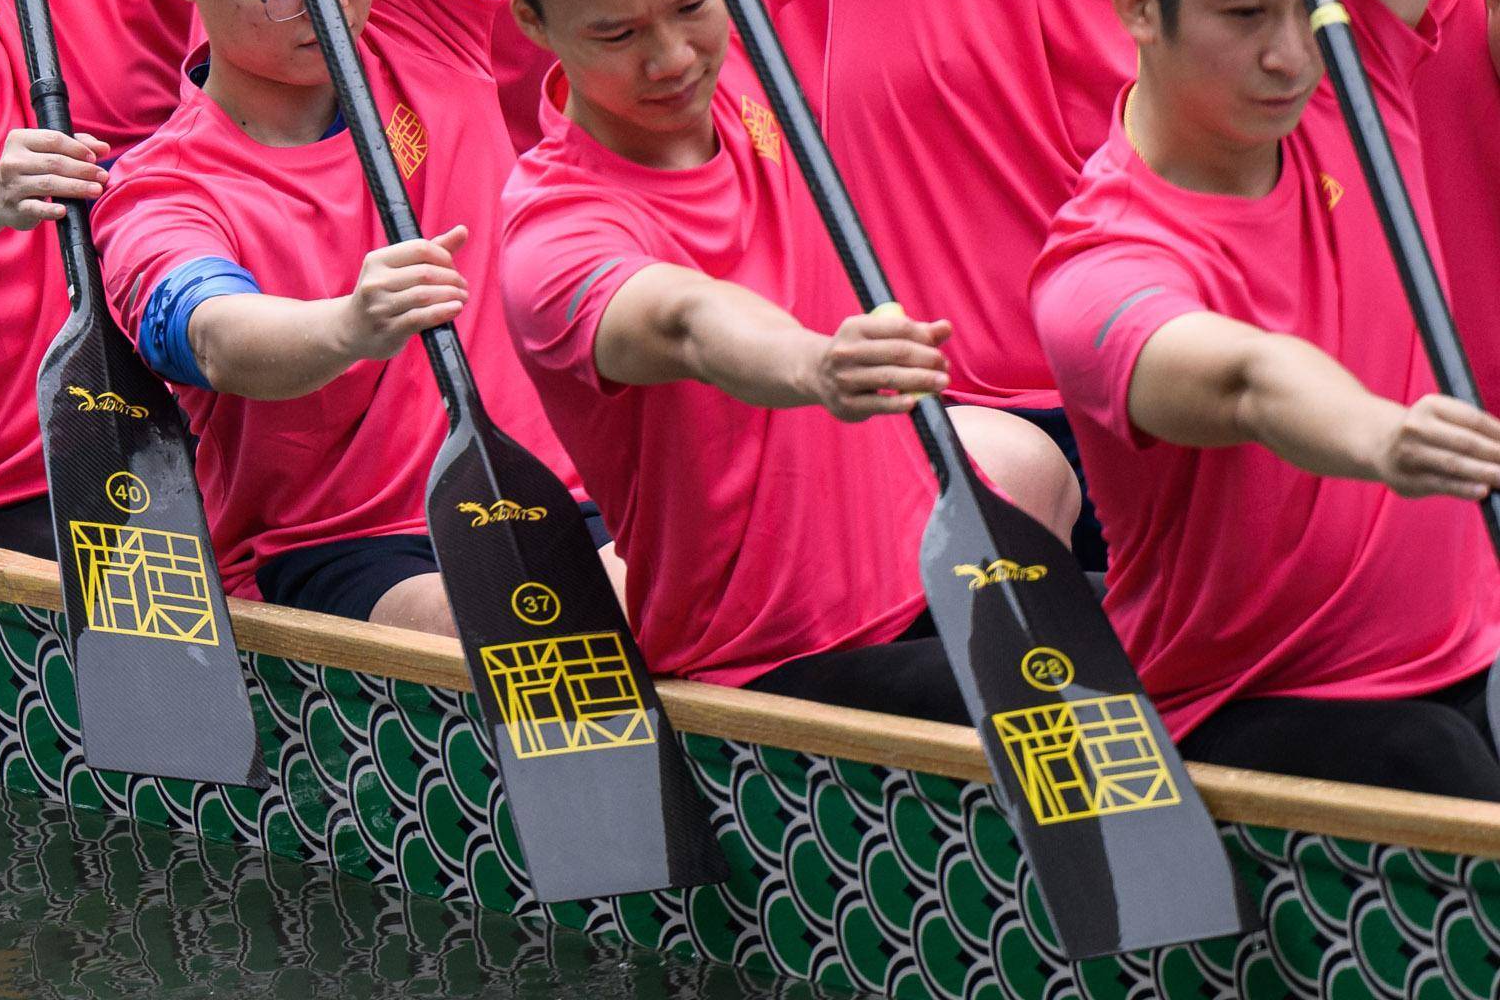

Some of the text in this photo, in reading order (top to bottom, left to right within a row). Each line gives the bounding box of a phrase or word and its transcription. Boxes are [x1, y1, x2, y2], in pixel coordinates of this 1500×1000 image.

[115, 484, 142, 502] 40
[522, 595, 550, 613] 37
[1031, 658, 1064, 680] 28
